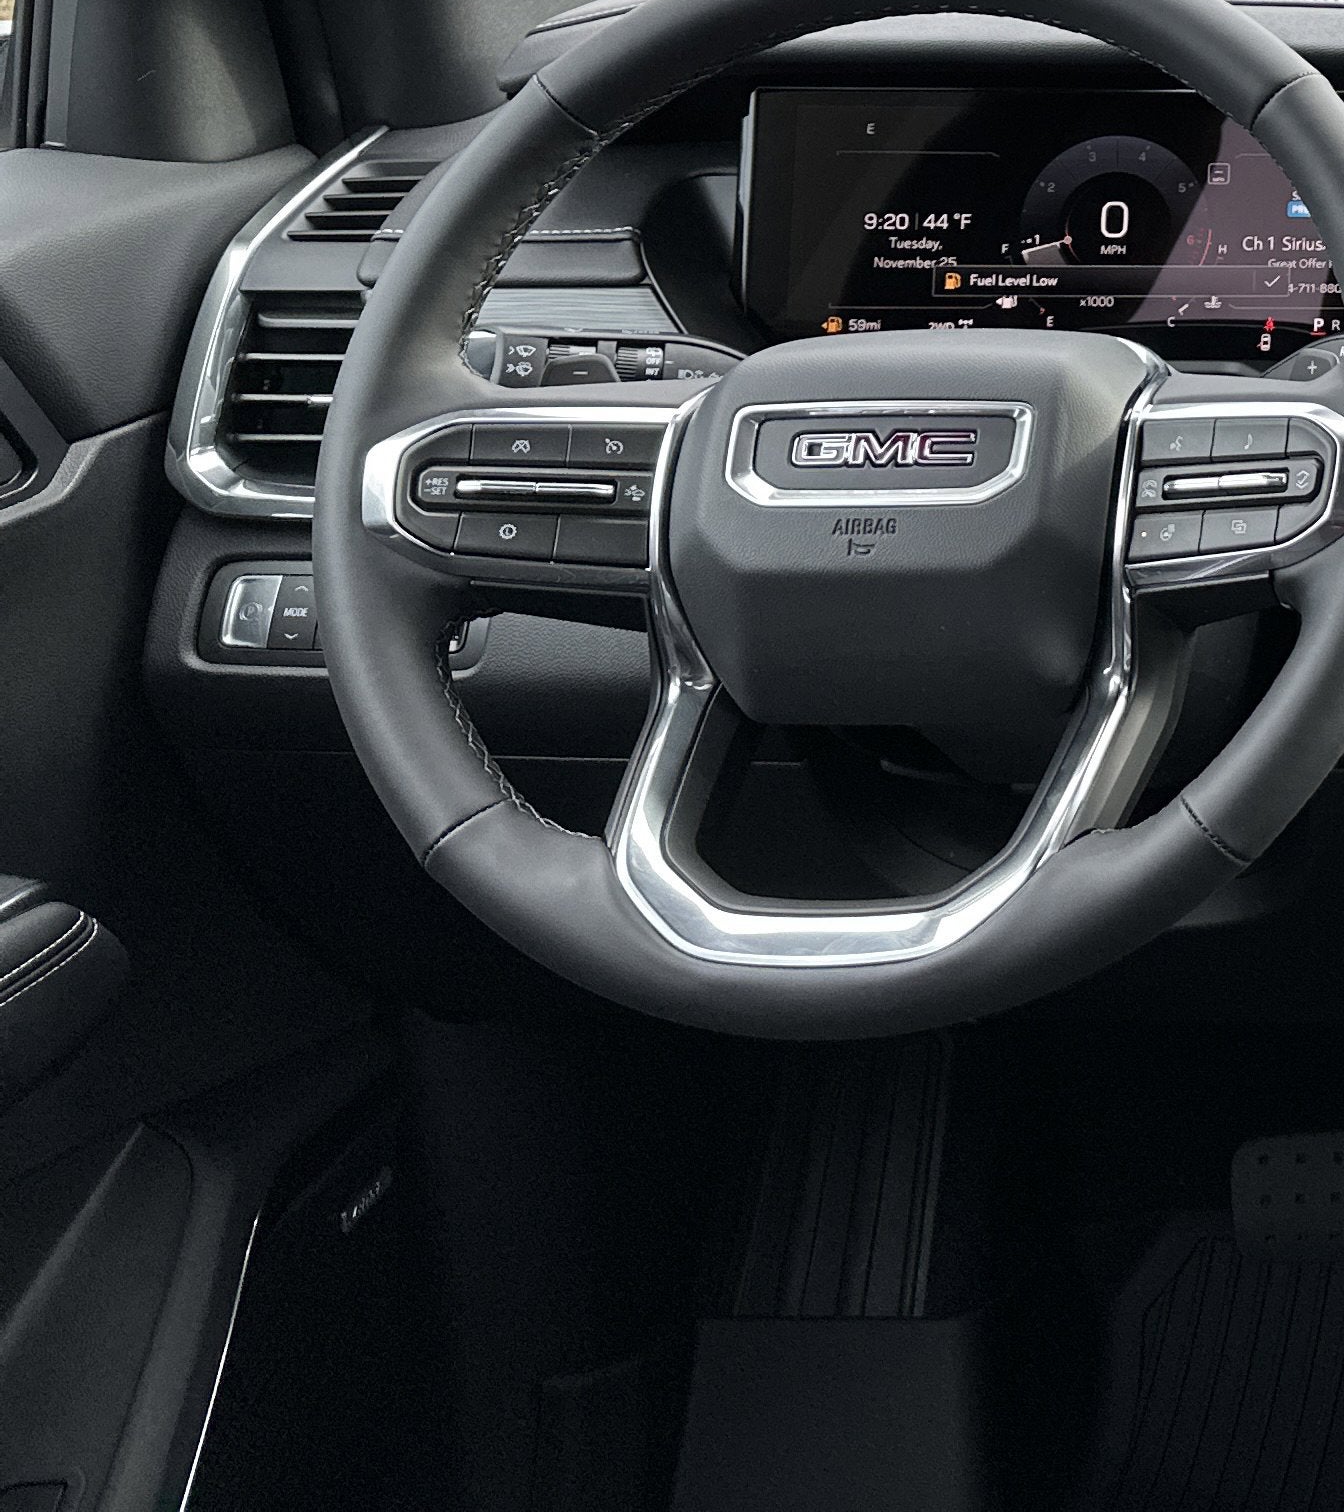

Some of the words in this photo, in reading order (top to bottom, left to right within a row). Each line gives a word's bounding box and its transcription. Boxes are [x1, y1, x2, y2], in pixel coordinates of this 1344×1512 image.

[867, 123, 875, 135] E
[1088, 152, 1097, 162] 3
[1138, 152, 1147, 162] 4
[1047, 182, 1056, 192] 2
[1178, 183, 1186, 193] 5
[864, 213, 910, 230] 9:20
[922, 213, 949, 230] 44
[1100, 201, 1129, 238] 0
[889, 237, 943, 252] Tuesday,
[1001, 243, 1009, 254] F
[1242, 236, 1263, 251] Ch
[1268, 237, 1274, 250] 1
[1282, 237, 1327, 251] Sirius
[1100, 245, 1126, 255] MPH
[1218, 245, 1227, 254] H
[873, 256, 936, 269] November
[1268, 259, 1297, 268] Great
[1299, 258, 1326, 269] Offer
[970, 274, 996, 286] Fuel
[998, 274, 1031, 286] Level
[1033, 274, 1059, 286] Low
[1080, 297, 1114, 308] x1000
[848, 319, 881, 331] 59mi
[1046, 316, 1054, 327] E
[1167, 317, 1176, 327] C
[1313, 317, 1324, 331] P
[1331, 320, 1340, 331] R
[791, 431, 977, 468] GMC
[832, 518, 897, 536] AIRBAG
[283, 607, 309, 617] MODE
